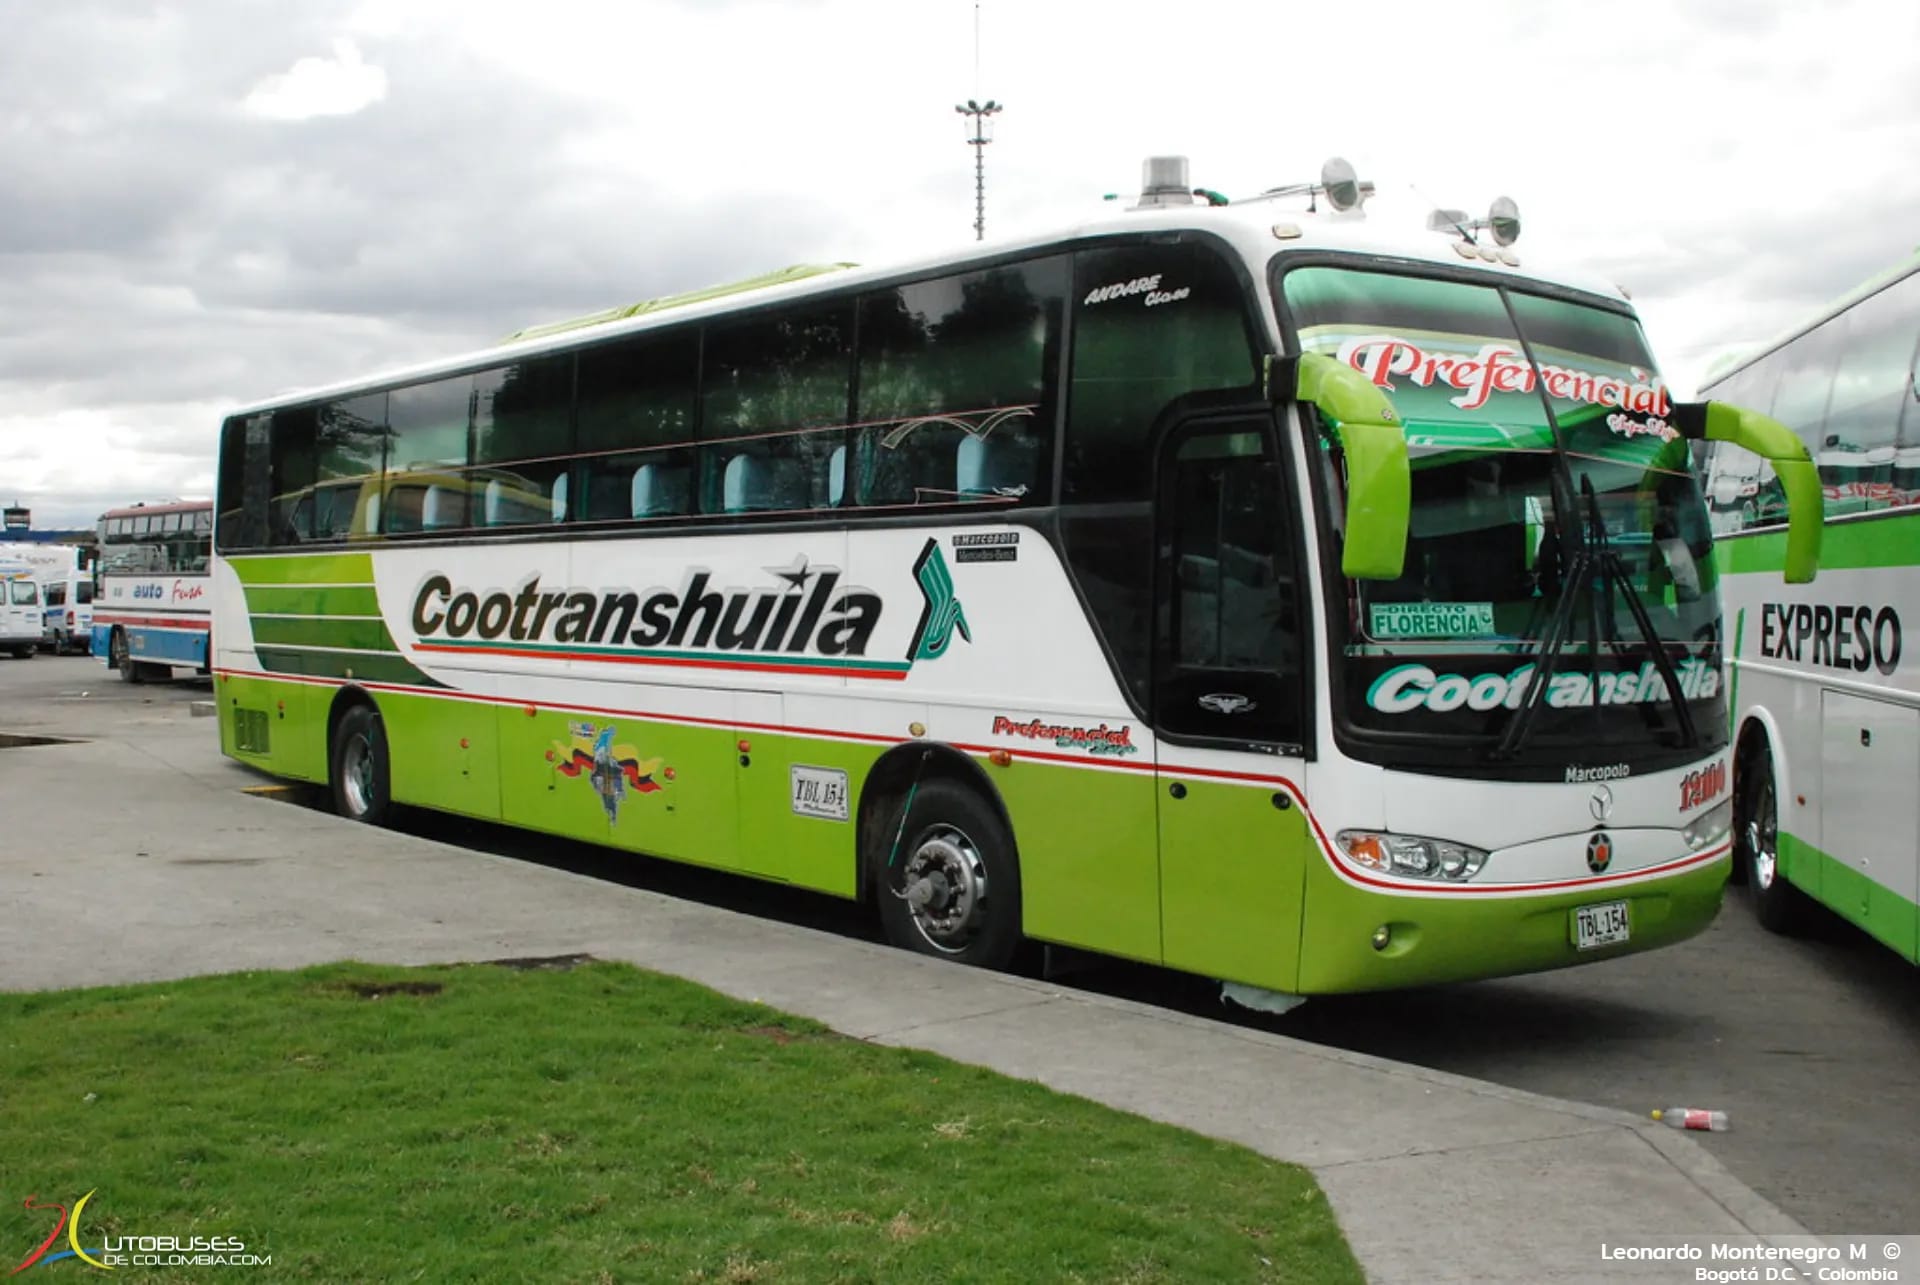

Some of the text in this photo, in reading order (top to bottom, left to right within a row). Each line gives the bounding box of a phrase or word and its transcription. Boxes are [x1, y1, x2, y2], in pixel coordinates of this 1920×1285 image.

[1084, 274, 1162, 305] ANDARE
[1337, 336, 1671, 416] Preferencial
[962, 534, 1018, 546] Marcopolo
[133, 584, 163, 599] auto
[411, 560, 884, 657] Cootranshuila
[1388, 605, 1466, 614] DIRECTO
[1374, 615, 1479, 633] FLORENCIA
[1761, 603, 1902, 676] EXPRESO
[992, 715, 1132, 747] Preferencial
[1565, 763, 1630, 784] Marcopolo
